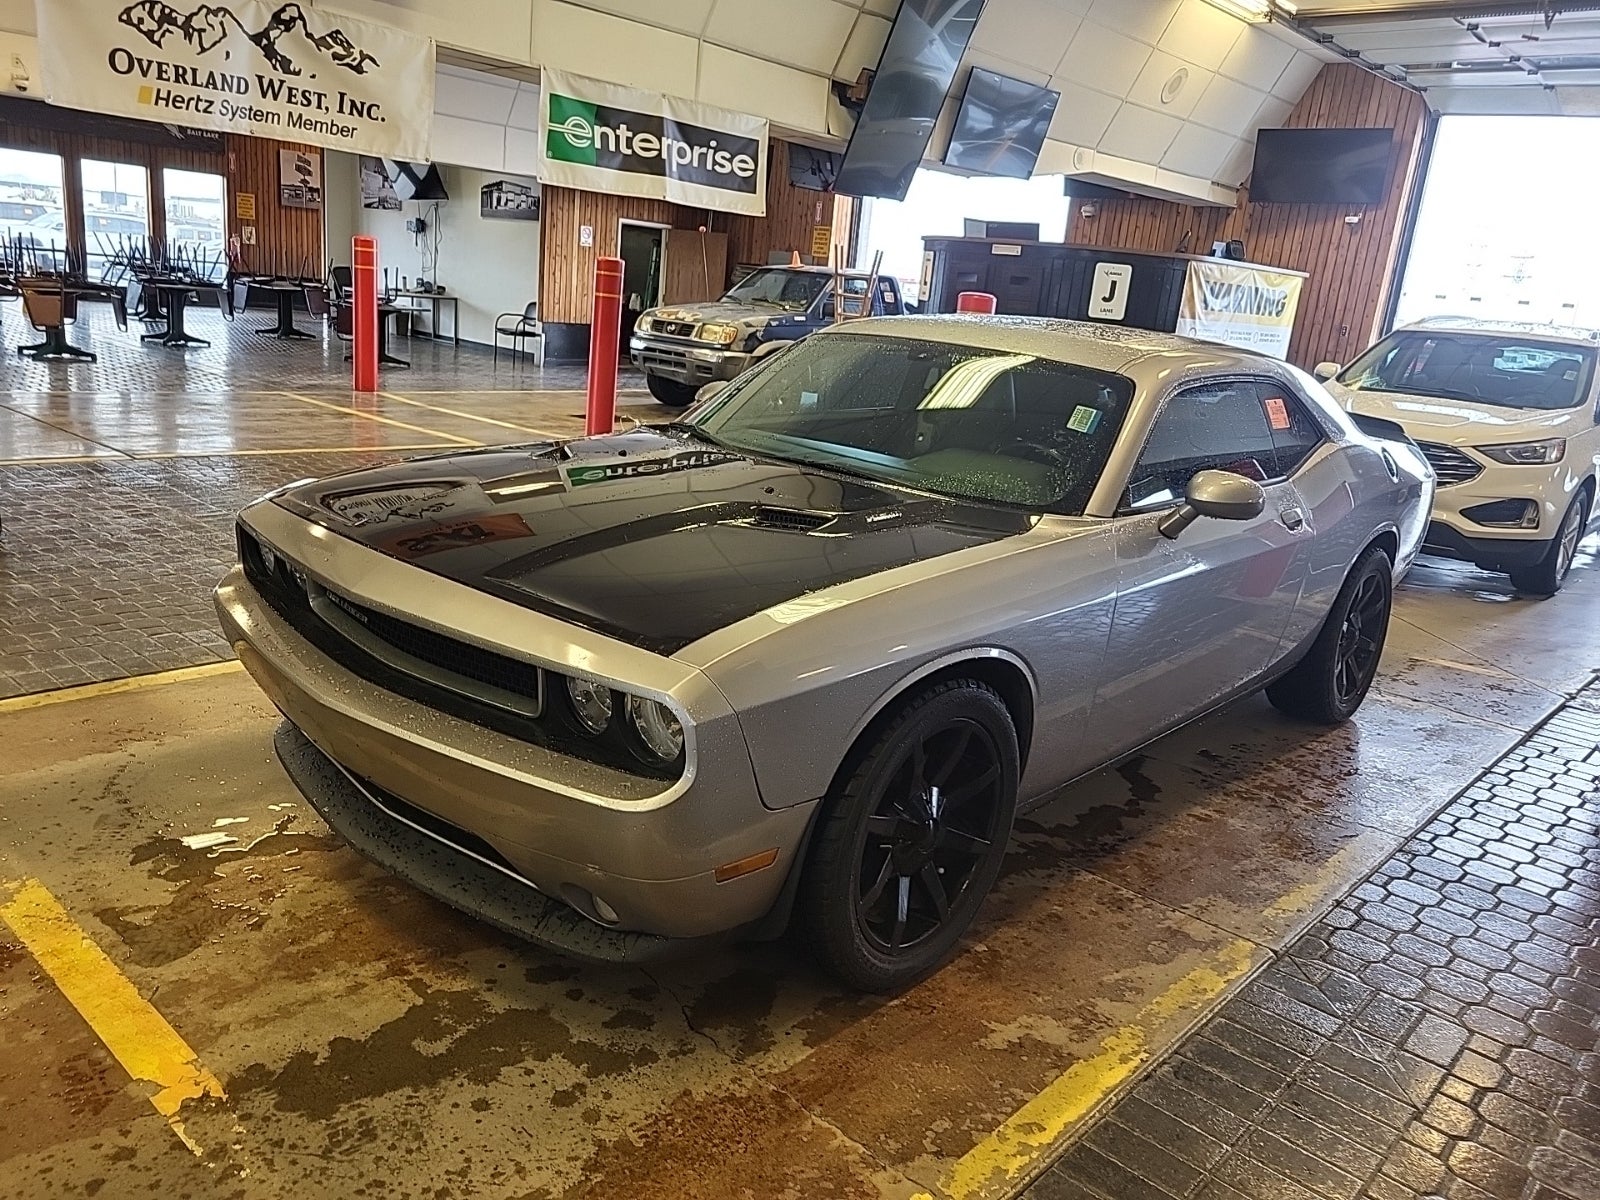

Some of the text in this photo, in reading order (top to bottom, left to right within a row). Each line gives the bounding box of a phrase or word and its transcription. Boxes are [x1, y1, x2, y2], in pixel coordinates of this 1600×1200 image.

[108, 47, 387, 123] OVERLAND WEST, INC.
[153, 88, 358, 140] Hertz System Member
[562, 116, 756, 178] enterprise
[1101, 279, 1118, 303] J
[1203, 280, 1288, 318] WARNING
